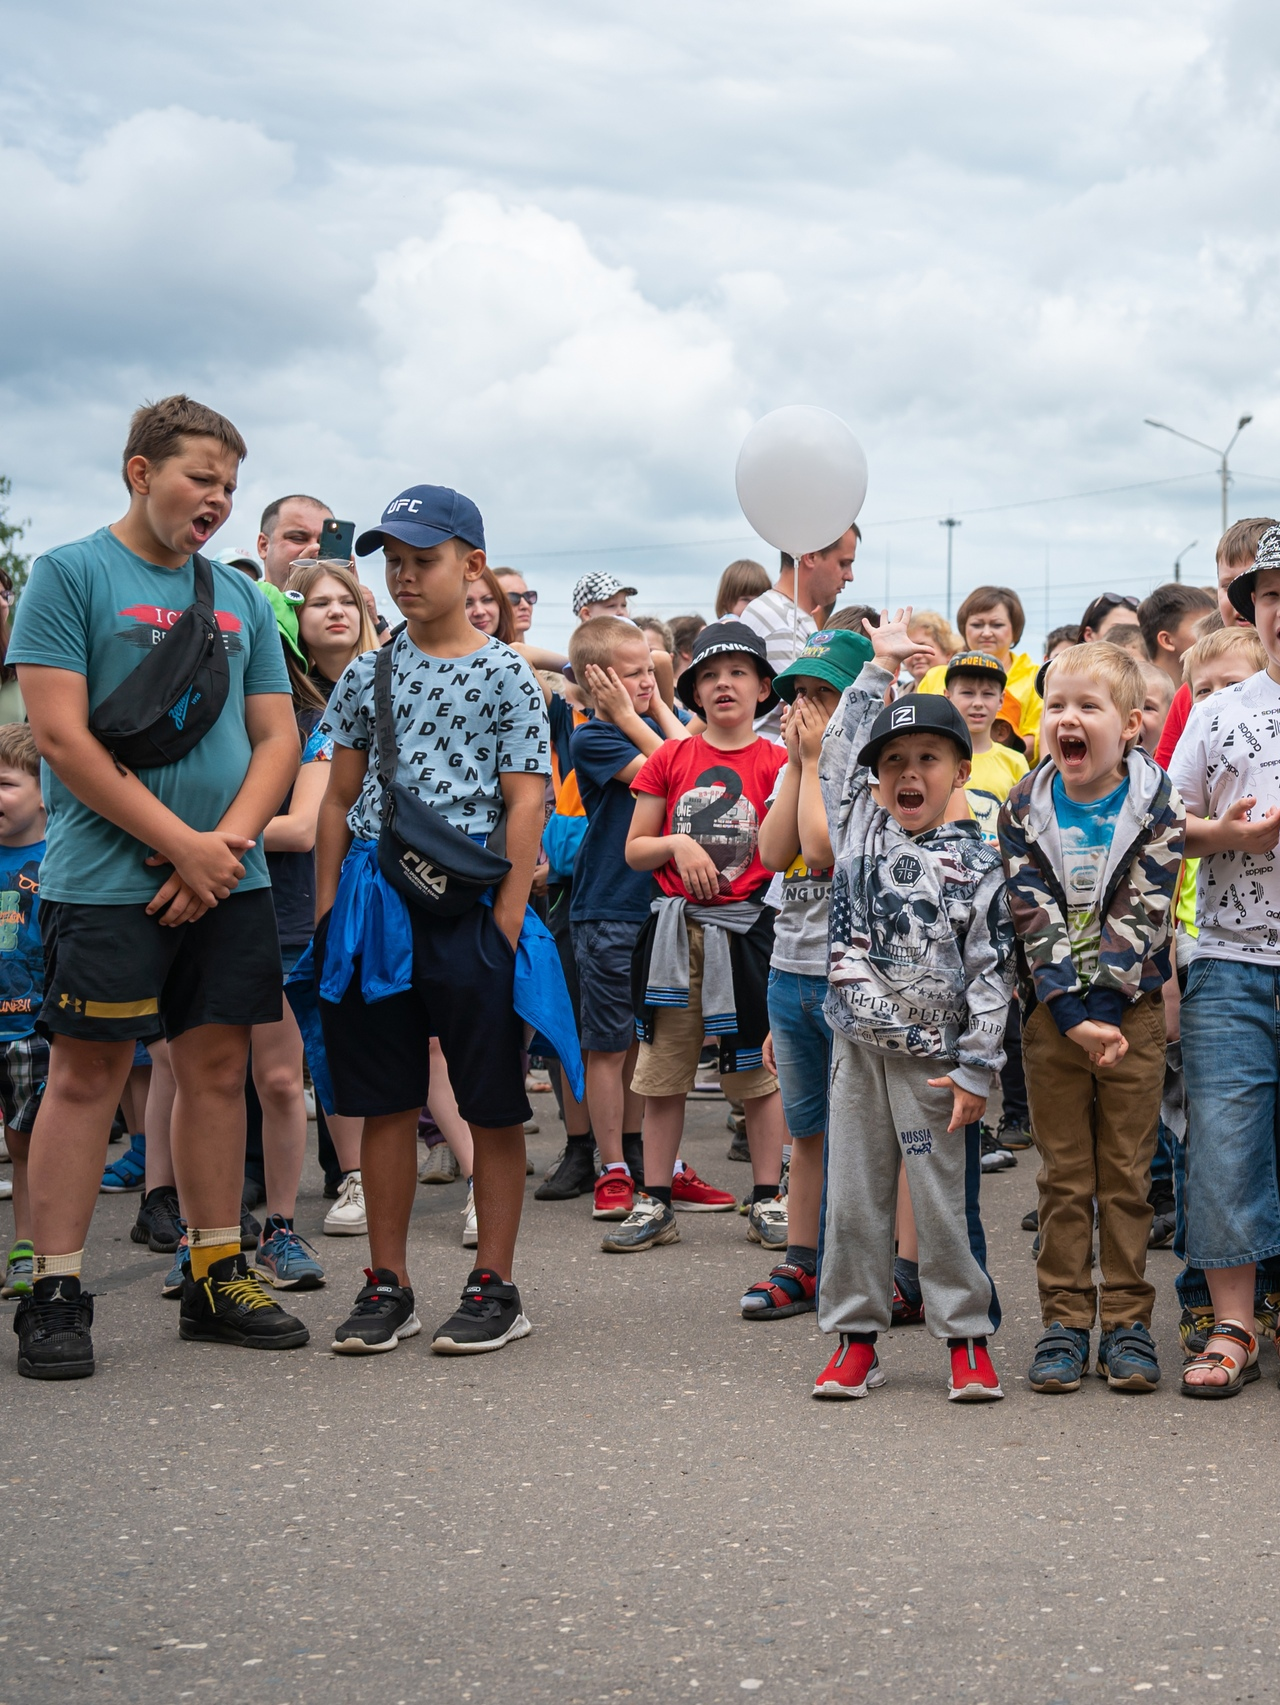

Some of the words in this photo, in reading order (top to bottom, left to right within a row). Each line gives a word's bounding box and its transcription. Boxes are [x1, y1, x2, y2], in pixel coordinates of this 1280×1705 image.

[387, 499, 422, 515] UFC
[895, 708, 912, 724] Z
[1238, 722, 1261, 752] adidas
[676, 805, 692, 817] ONE
[676, 822, 692, 834] TWO
[403, 850, 448, 894] FILA
[1245, 866, 1273, 877] adidas
[908, 1007, 967, 1024] PLEIN
[901, 1128, 932, 1144] RUSSIA
